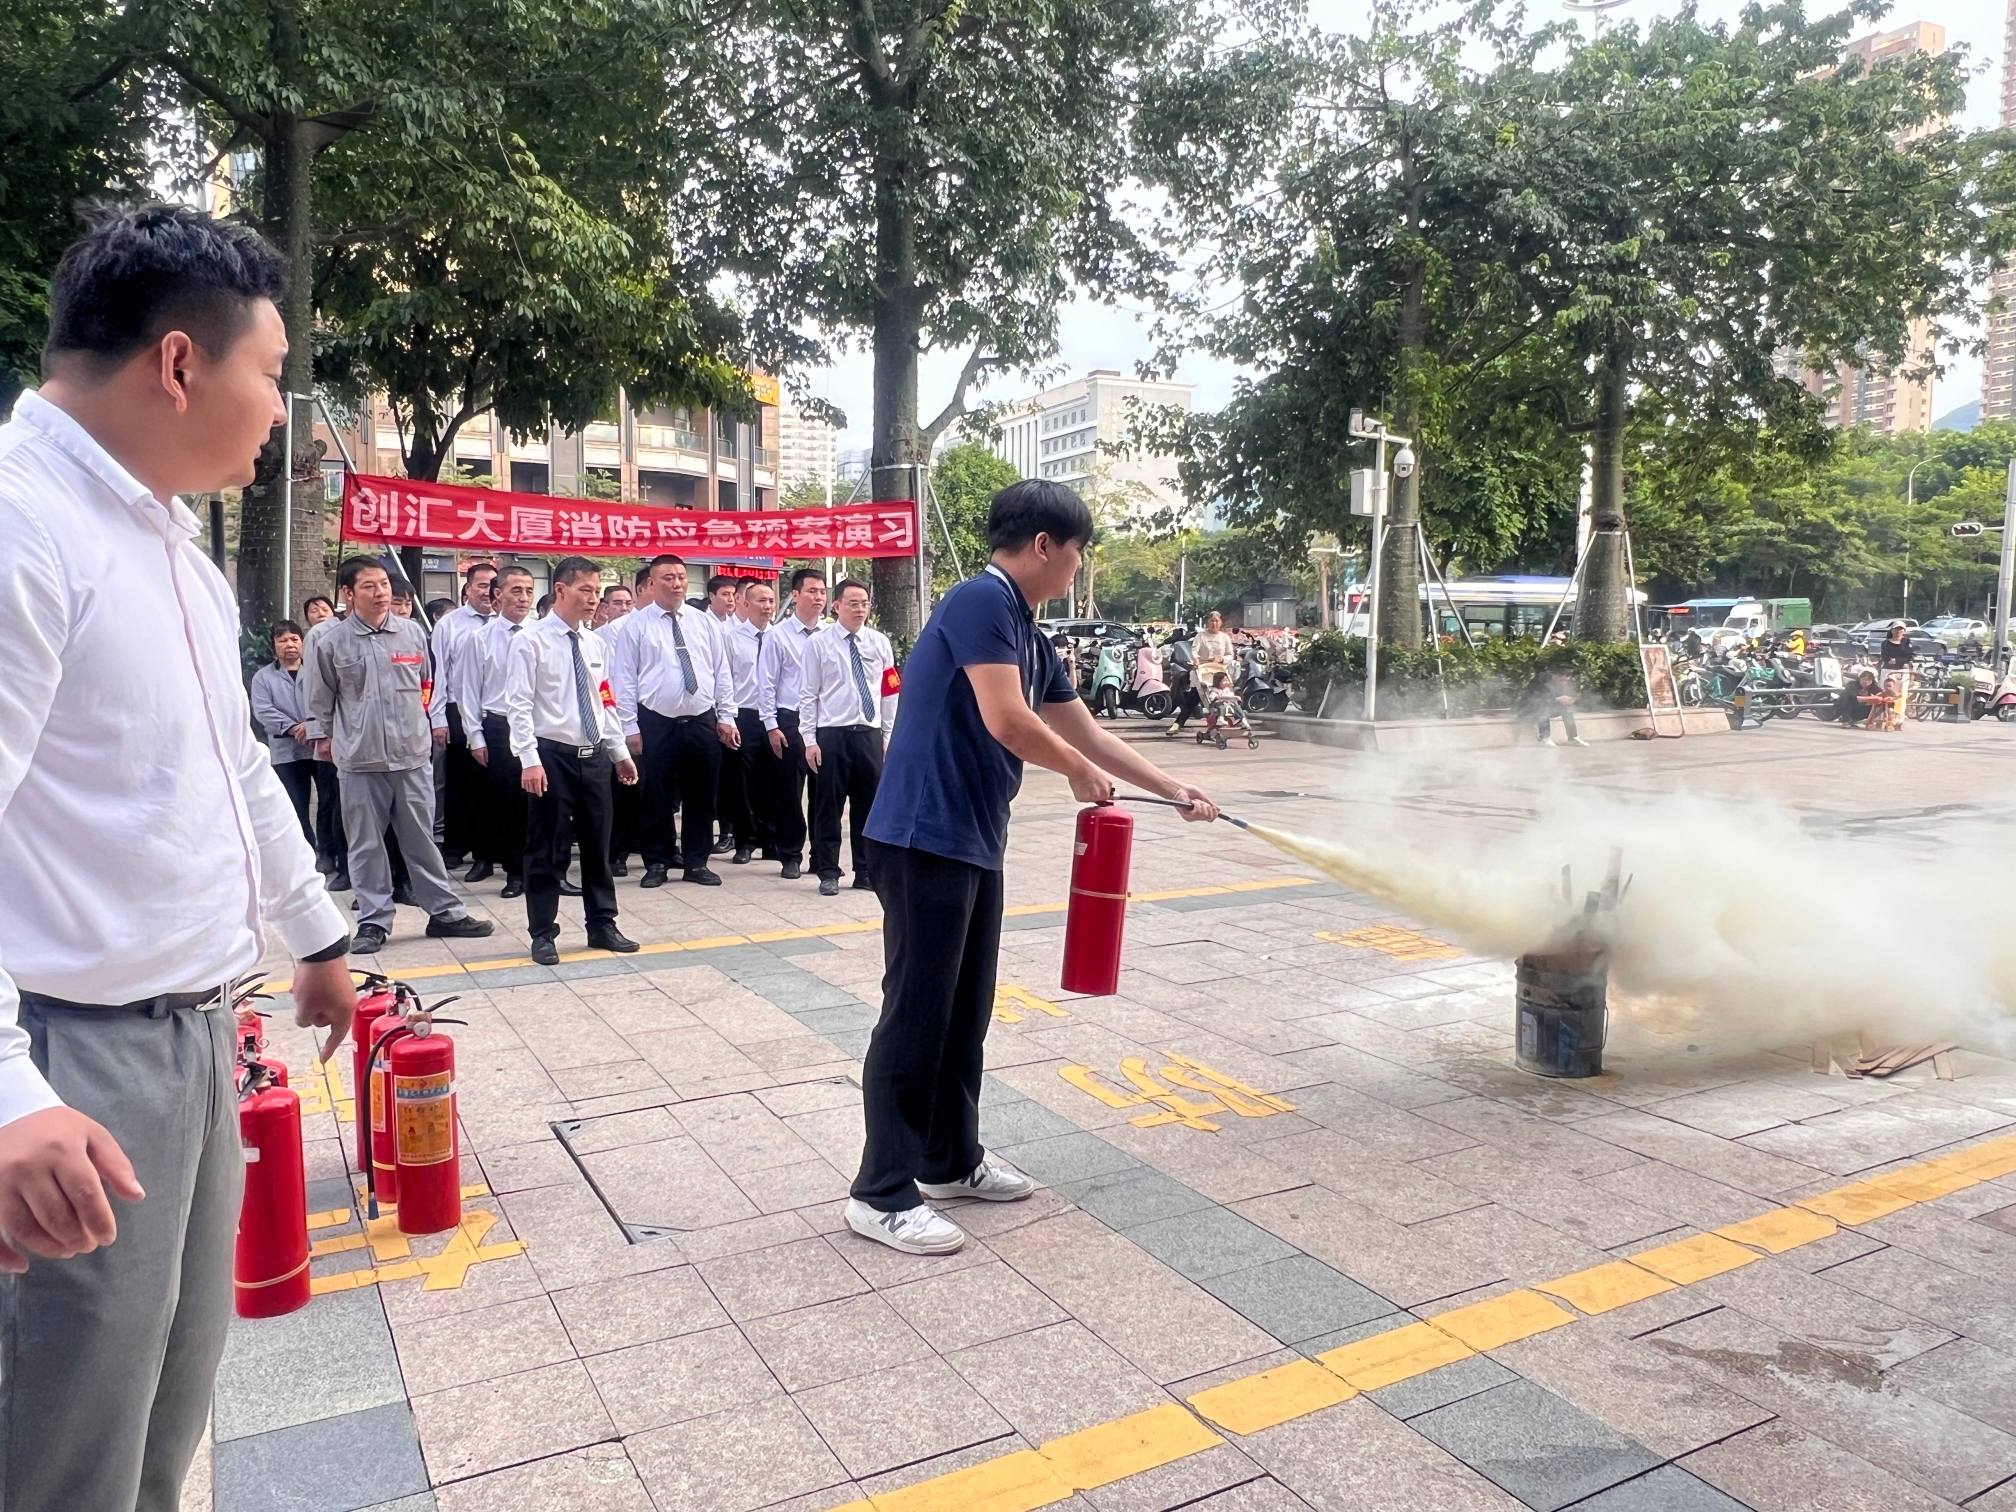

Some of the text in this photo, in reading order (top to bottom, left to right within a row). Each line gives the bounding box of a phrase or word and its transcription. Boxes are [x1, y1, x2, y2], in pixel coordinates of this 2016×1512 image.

[350, 487, 912, 548] 创汇大厦消防应急预案演习
[879, 1212, 907, 1233] N
